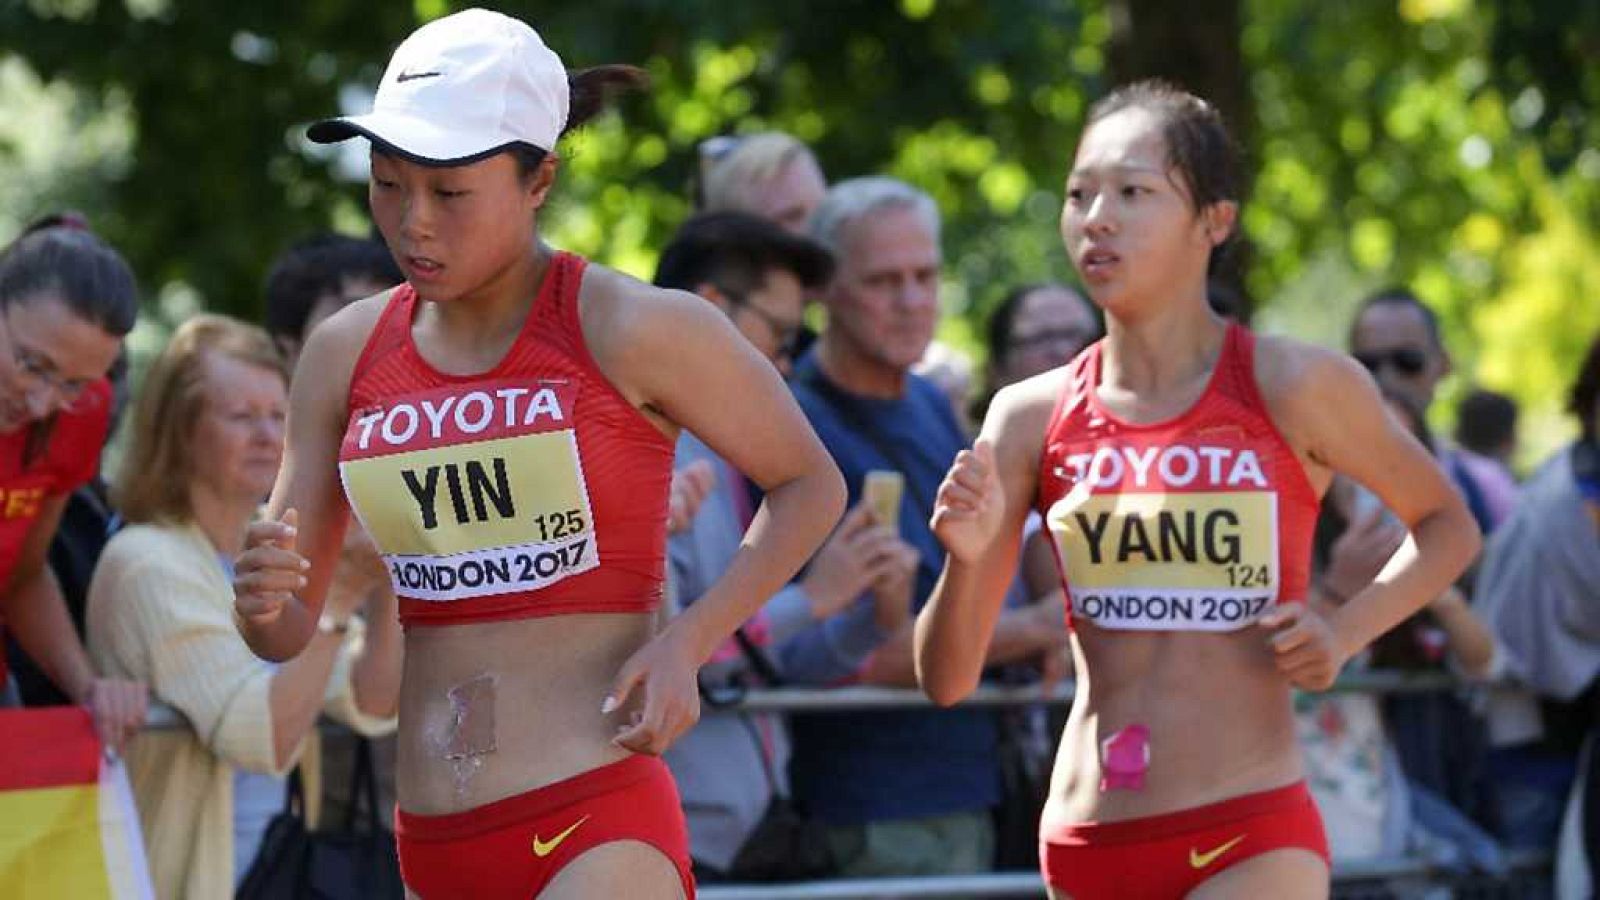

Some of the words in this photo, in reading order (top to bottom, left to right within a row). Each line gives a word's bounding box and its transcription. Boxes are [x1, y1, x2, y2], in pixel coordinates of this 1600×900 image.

[356, 388, 563, 449] TOYOTA
[1065, 445, 1268, 488] TOYOTA
[402, 457, 515, 530] YIN
[535, 510, 585, 541] 125
[1074, 509, 1242, 565] YANG
[392, 557, 510, 592] LONDON
[514, 540, 588, 580] 2017
[1226, 565, 1271, 587] 124
[1200, 597, 1270, 621] 2017
